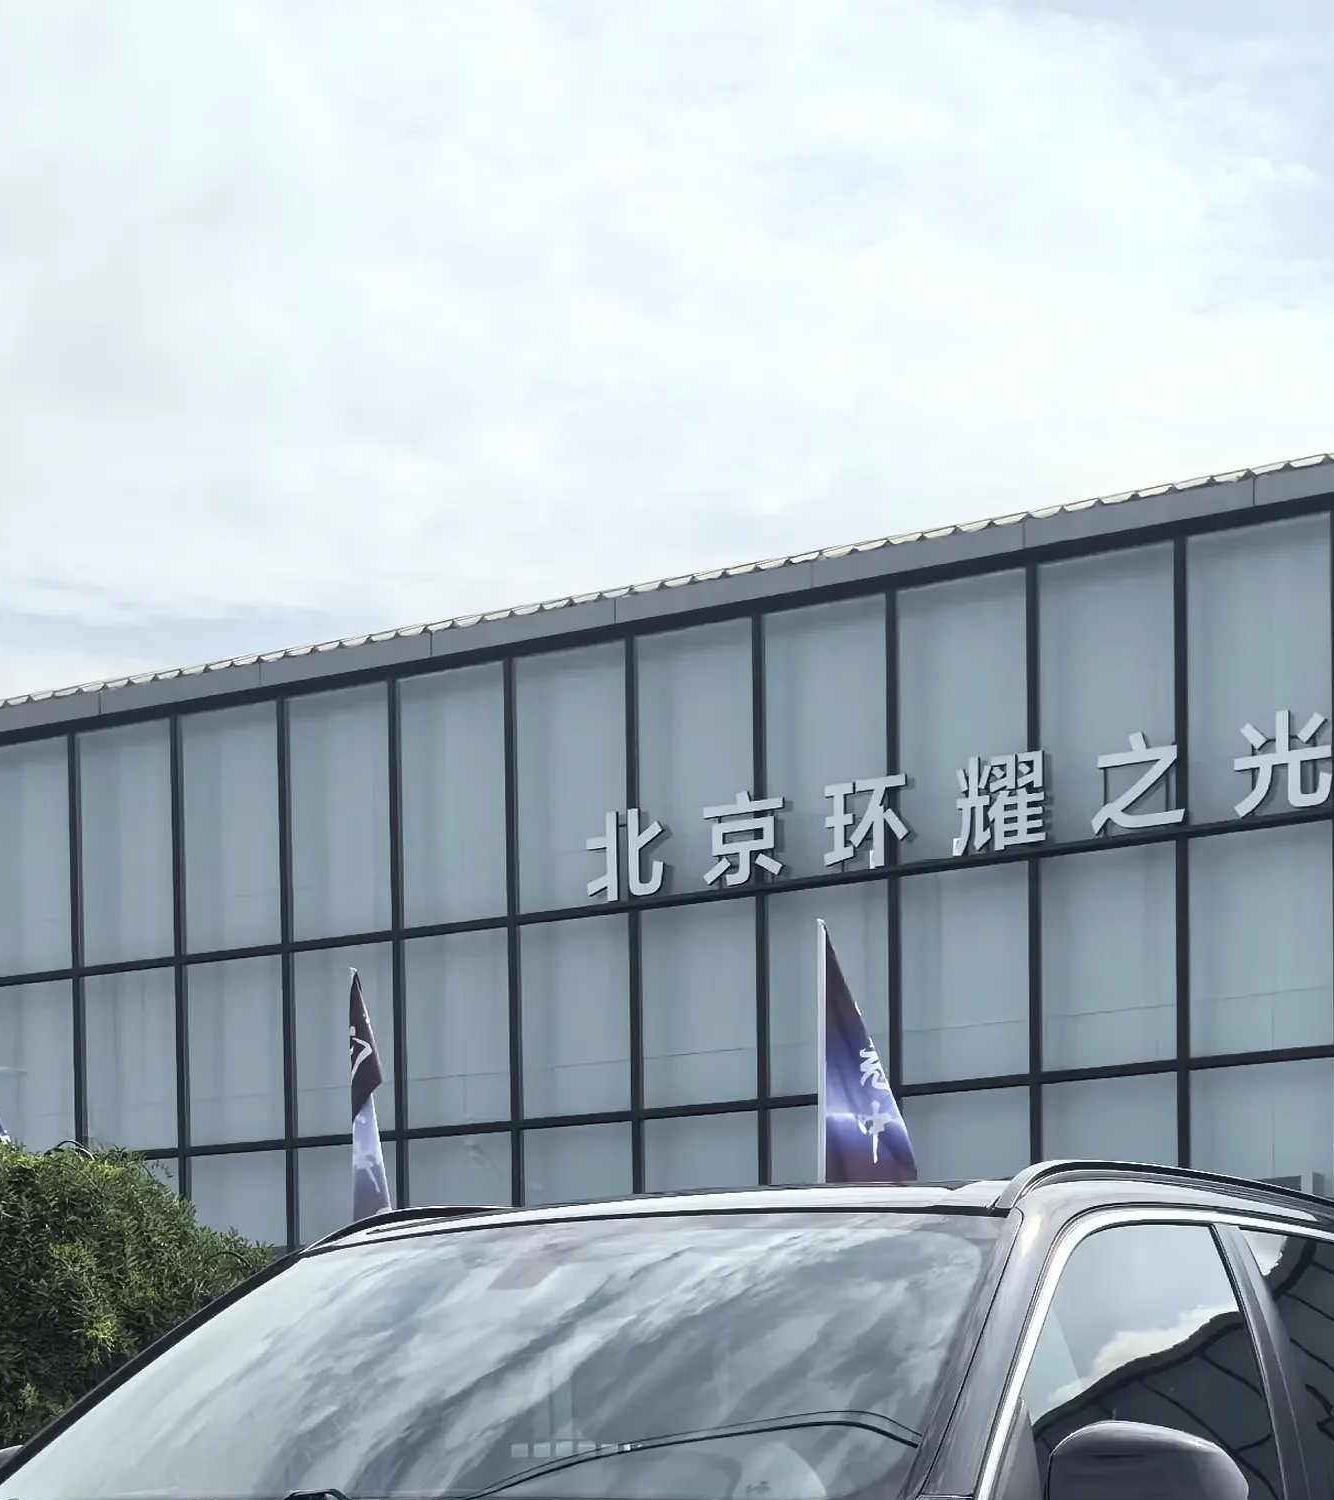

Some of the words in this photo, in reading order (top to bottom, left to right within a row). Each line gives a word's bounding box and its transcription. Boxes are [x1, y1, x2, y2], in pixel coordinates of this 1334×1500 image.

[586, 710, 1334, 902] 北京环耀之光
